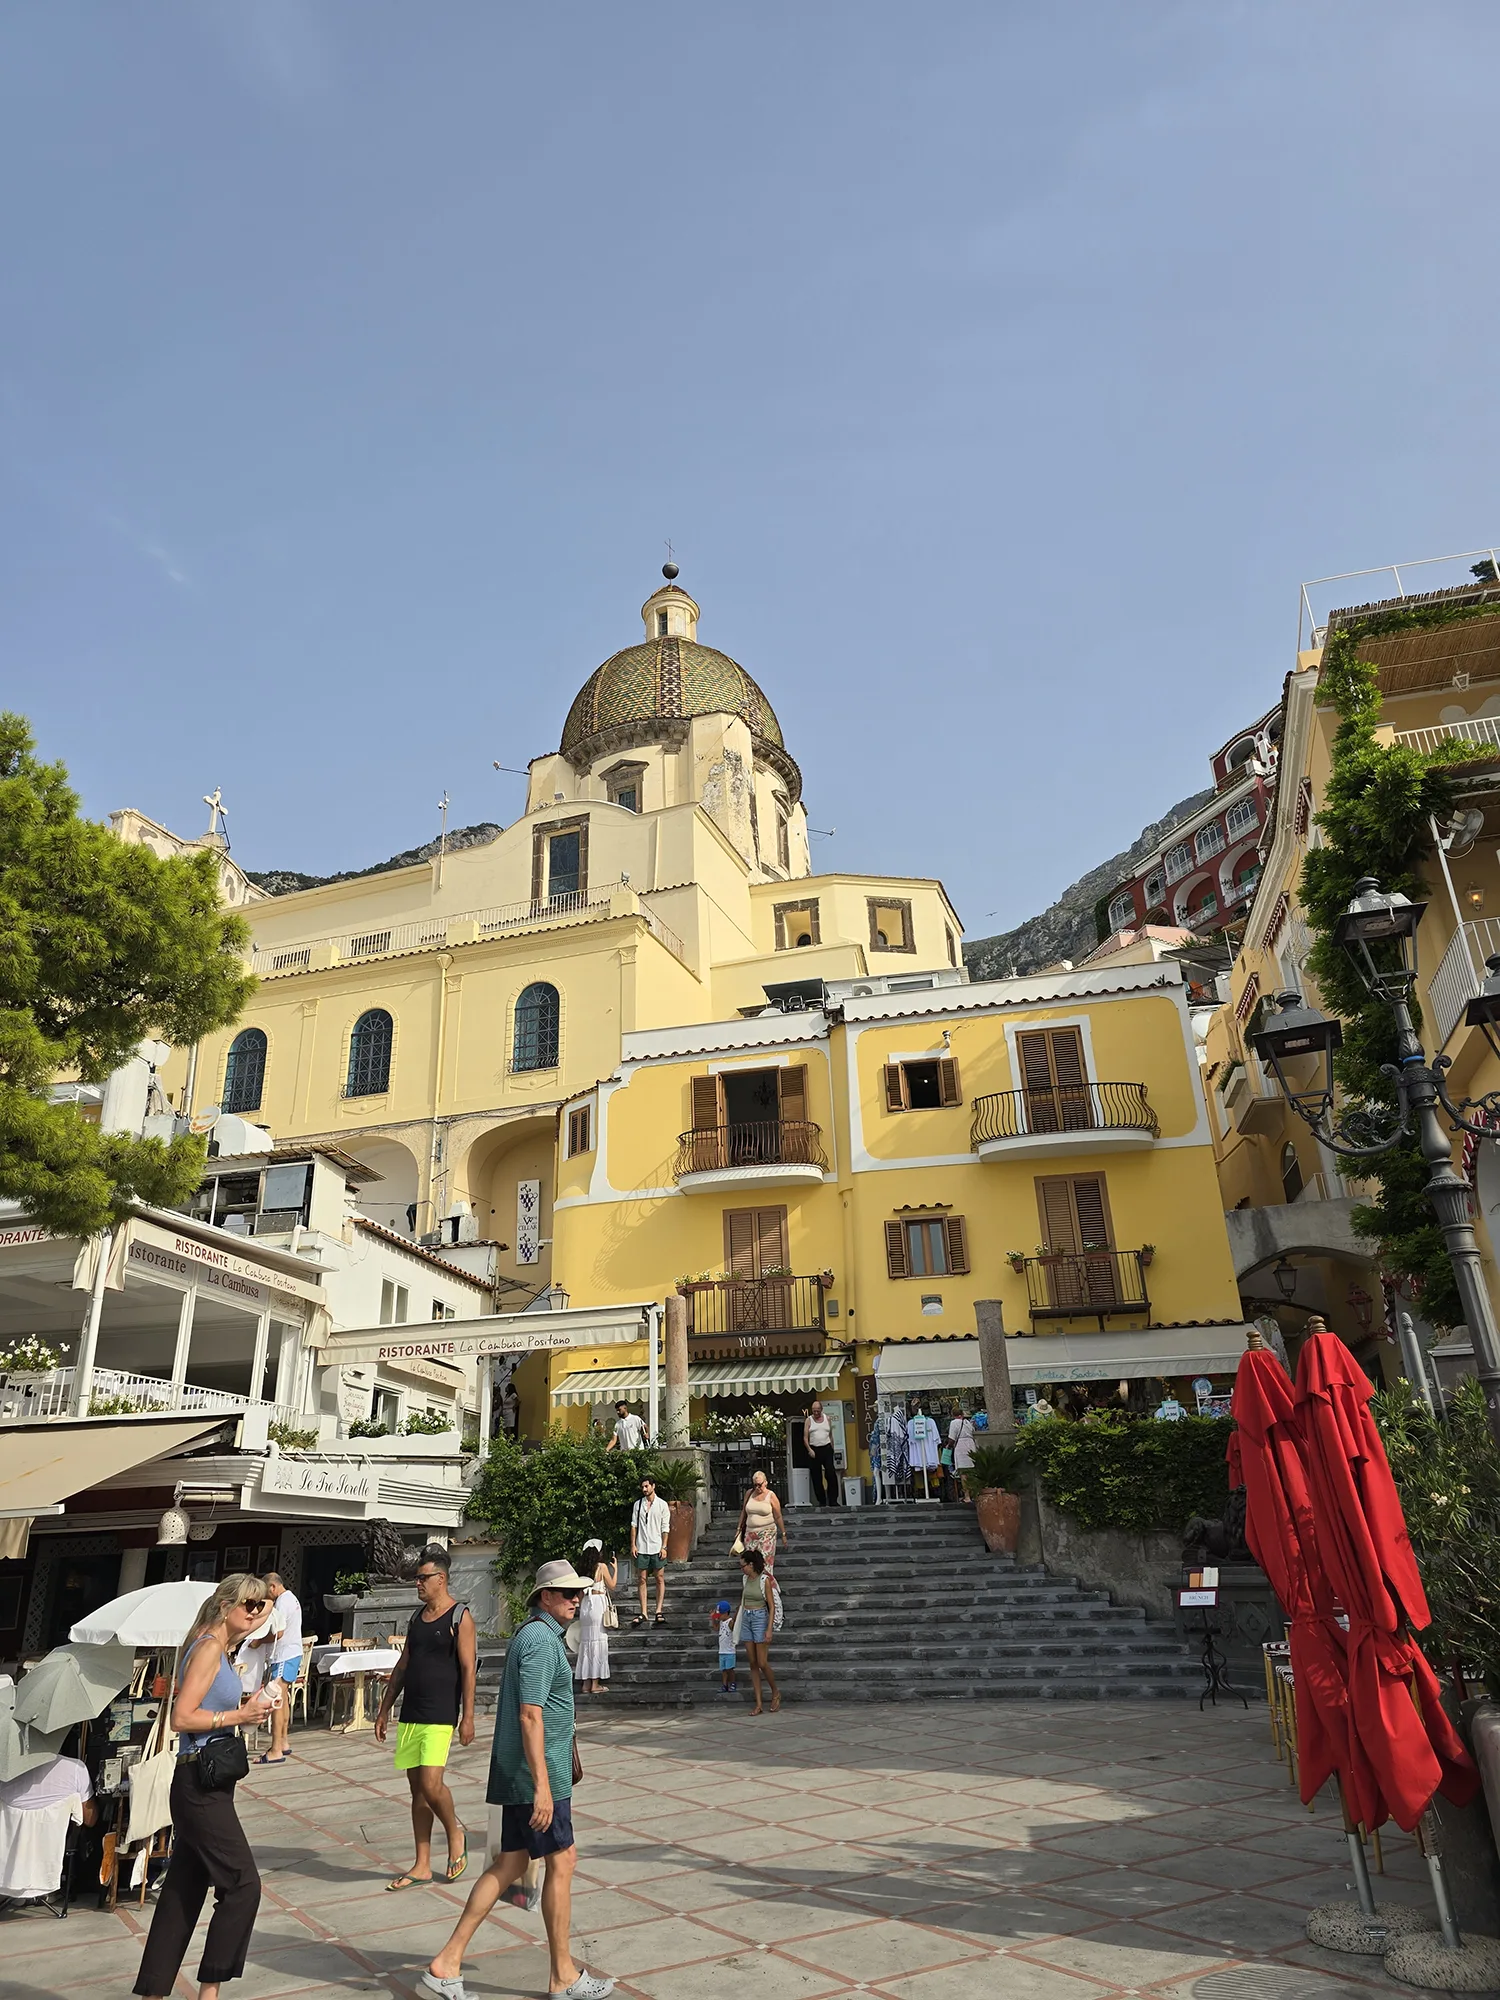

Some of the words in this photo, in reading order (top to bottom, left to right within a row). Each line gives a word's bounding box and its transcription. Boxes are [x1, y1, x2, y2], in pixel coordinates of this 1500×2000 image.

[175, 1238, 229, 1268] RISTORANTE
[232, 1259, 242, 1273] La
[129, 1244, 187, 1274] istorante
[207, 1268, 220, 1286] La
[221, 1273, 260, 1299] Cambusa
[378, 1342, 454, 1358] RISTORANTE
[460, 1341, 474, 1353] La
[479, 1338, 523, 1352] Cambusa
[527, 1334, 571, 1347] Positano
[738, 1335, 768, 1348] YUMMY
[299, 1468, 314, 1490] Le
[315, 1471, 333, 1493] Tre
[335, 1473, 370, 1497] Sorelle
